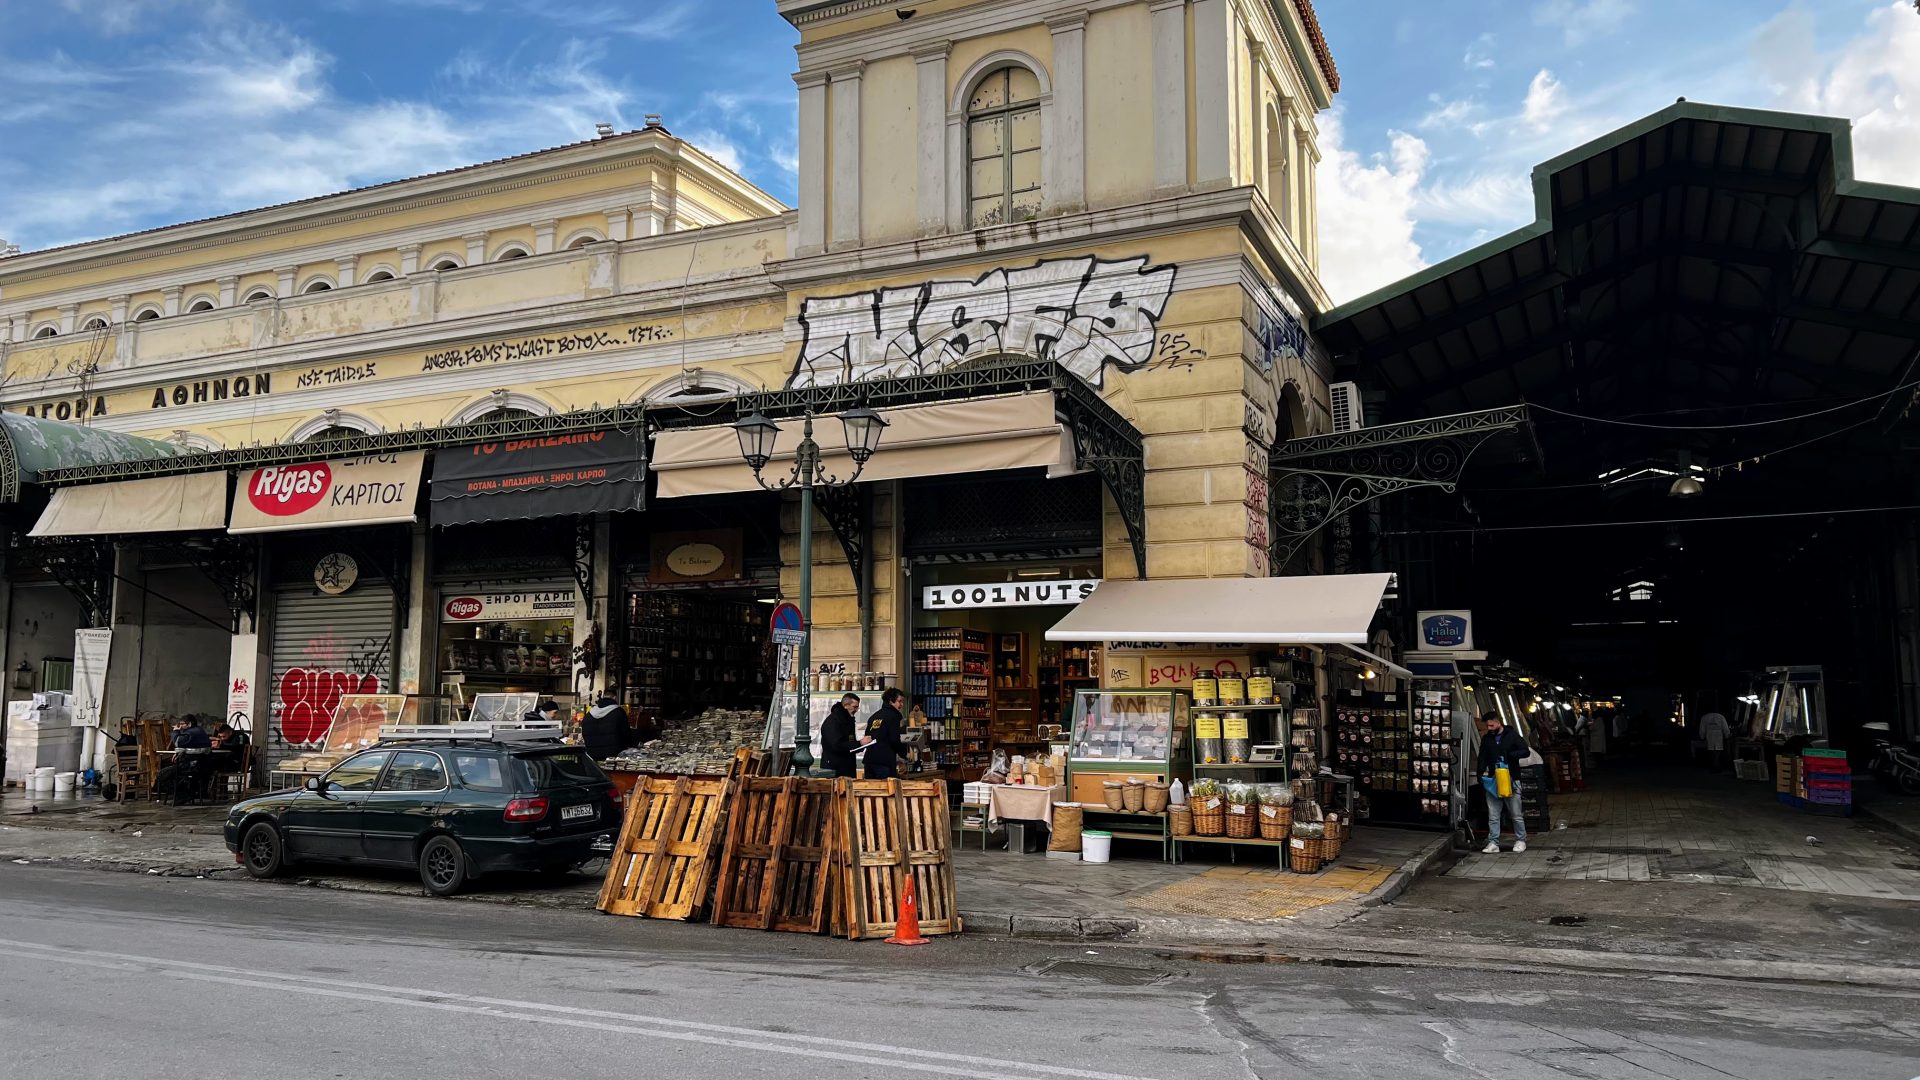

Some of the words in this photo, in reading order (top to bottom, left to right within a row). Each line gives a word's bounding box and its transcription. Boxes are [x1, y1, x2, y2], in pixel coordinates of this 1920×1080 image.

[26, 396, 107, 420] ΑΓΟΡΑ
[151, 373, 271, 408] ΑΘΗΝΩΝ
[254, 466, 326, 503] Rigas
[467, 480, 497, 491] ΒΟΤΑΝΑ
[502, 475, 545, 488] ΜΠΑΧΑΡΙΚΑ
[550, 471, 574, 483] ΞΗΡΟΙ
[577, 469, 607, 480] ΚΑΡΠΟΙ
[331, 482, 405, 507] ΚΑΡΠΟΙ
[450, 601, 480, 616] Rigas
[486, 595, 527, 604] ΞΗΡΟΙ
[534, 592, 575, 602] ΚΑΡΠ
[1431, 626, 1459, 636] Halal
